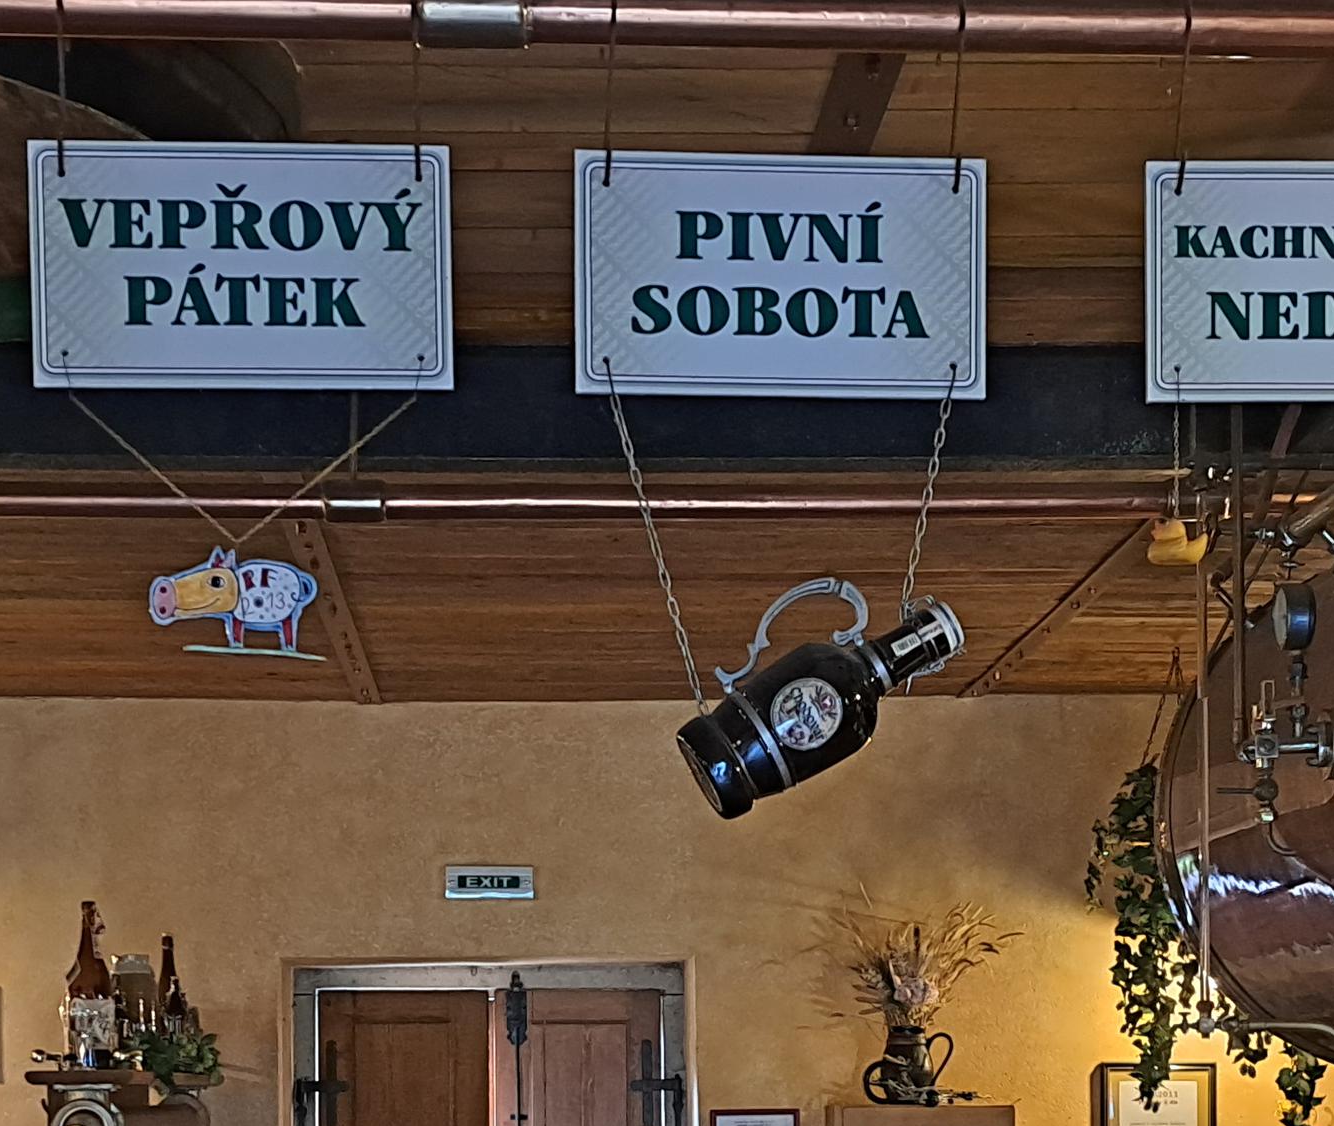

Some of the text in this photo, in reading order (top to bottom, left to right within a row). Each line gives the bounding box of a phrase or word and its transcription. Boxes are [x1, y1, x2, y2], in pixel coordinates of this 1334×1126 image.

[57, 183, 422, 253] VEPŘOVÝ
[675, 201, 884, 264] PIVNÍ
[123, 263, 366, 328] PÁTEK
[631, 284, 930, 339] SOBOTA
[465, 876, 512, 888] EXIT
